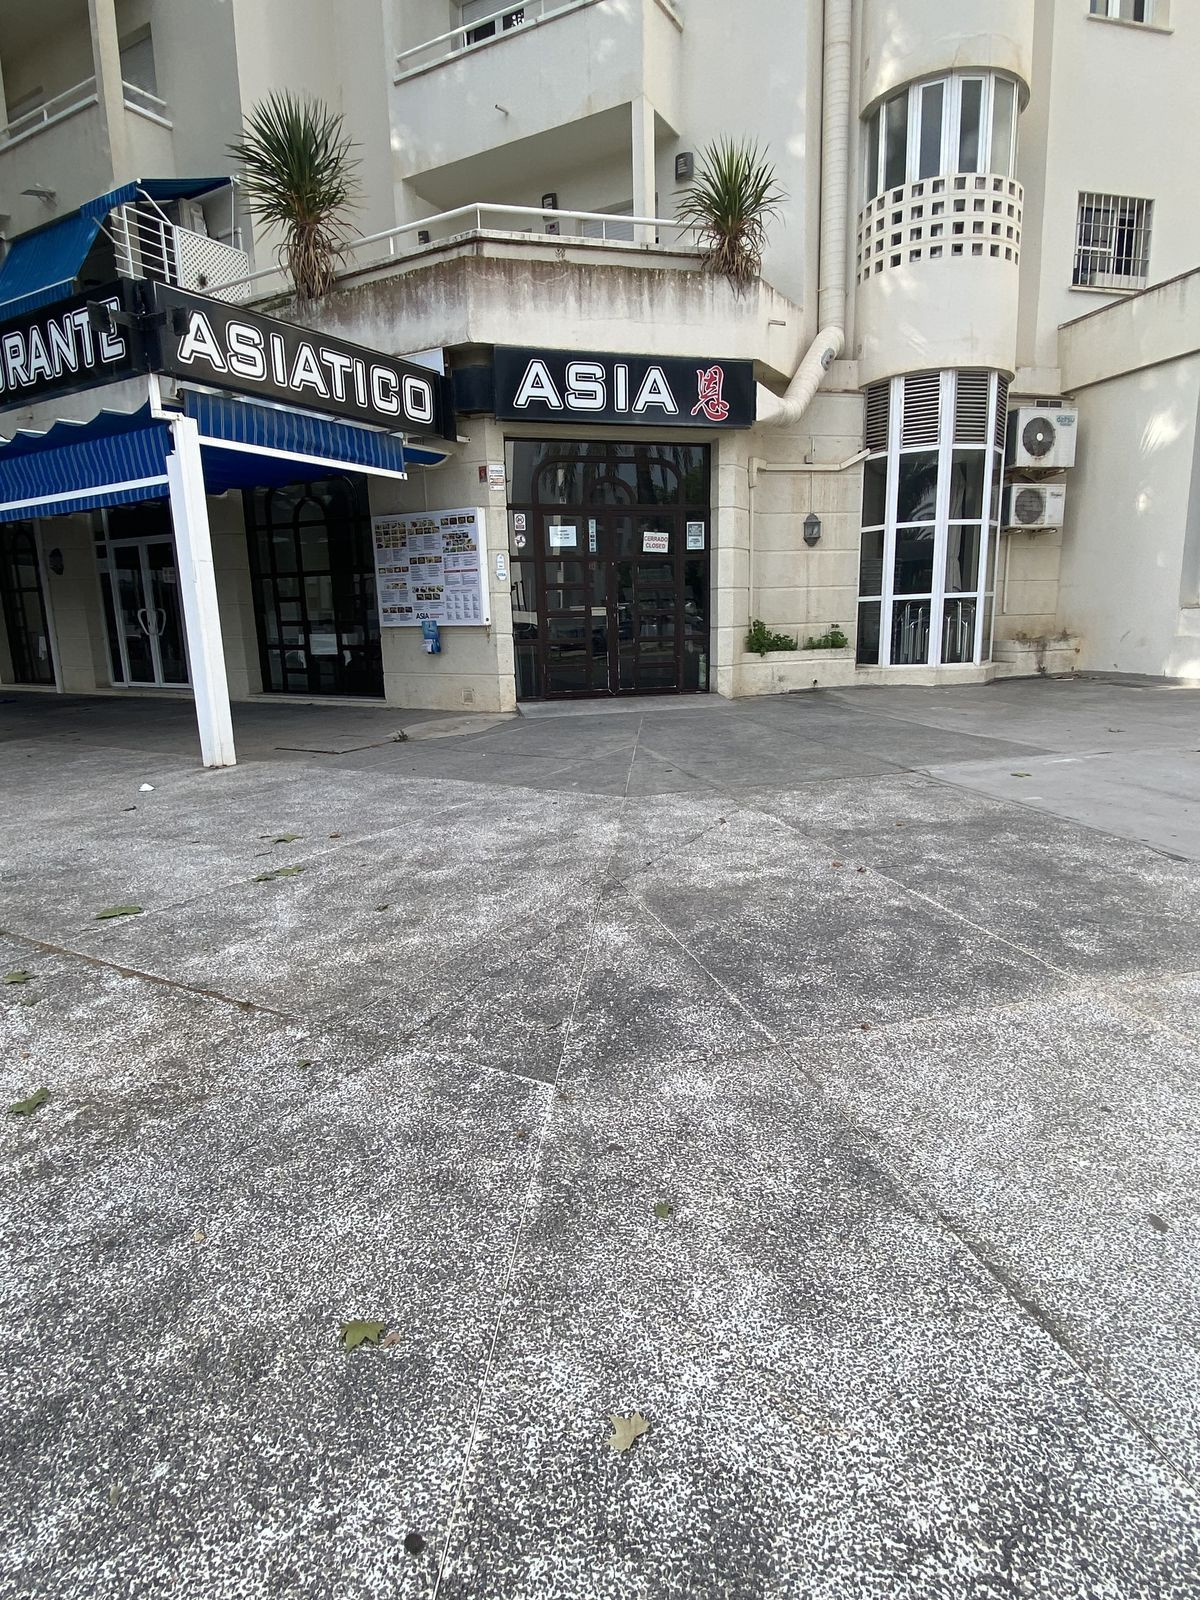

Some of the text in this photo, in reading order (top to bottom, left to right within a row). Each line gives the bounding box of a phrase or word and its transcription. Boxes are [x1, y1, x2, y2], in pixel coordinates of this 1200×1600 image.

[0, 296, 126, 394] RANTE
[177, 310, 434, 424] ASIATICO
[513, 359, 679, 415] ASIA
[644, 535, 668, 543] CERRADO
[416, 612, 430, 620] ASIA
